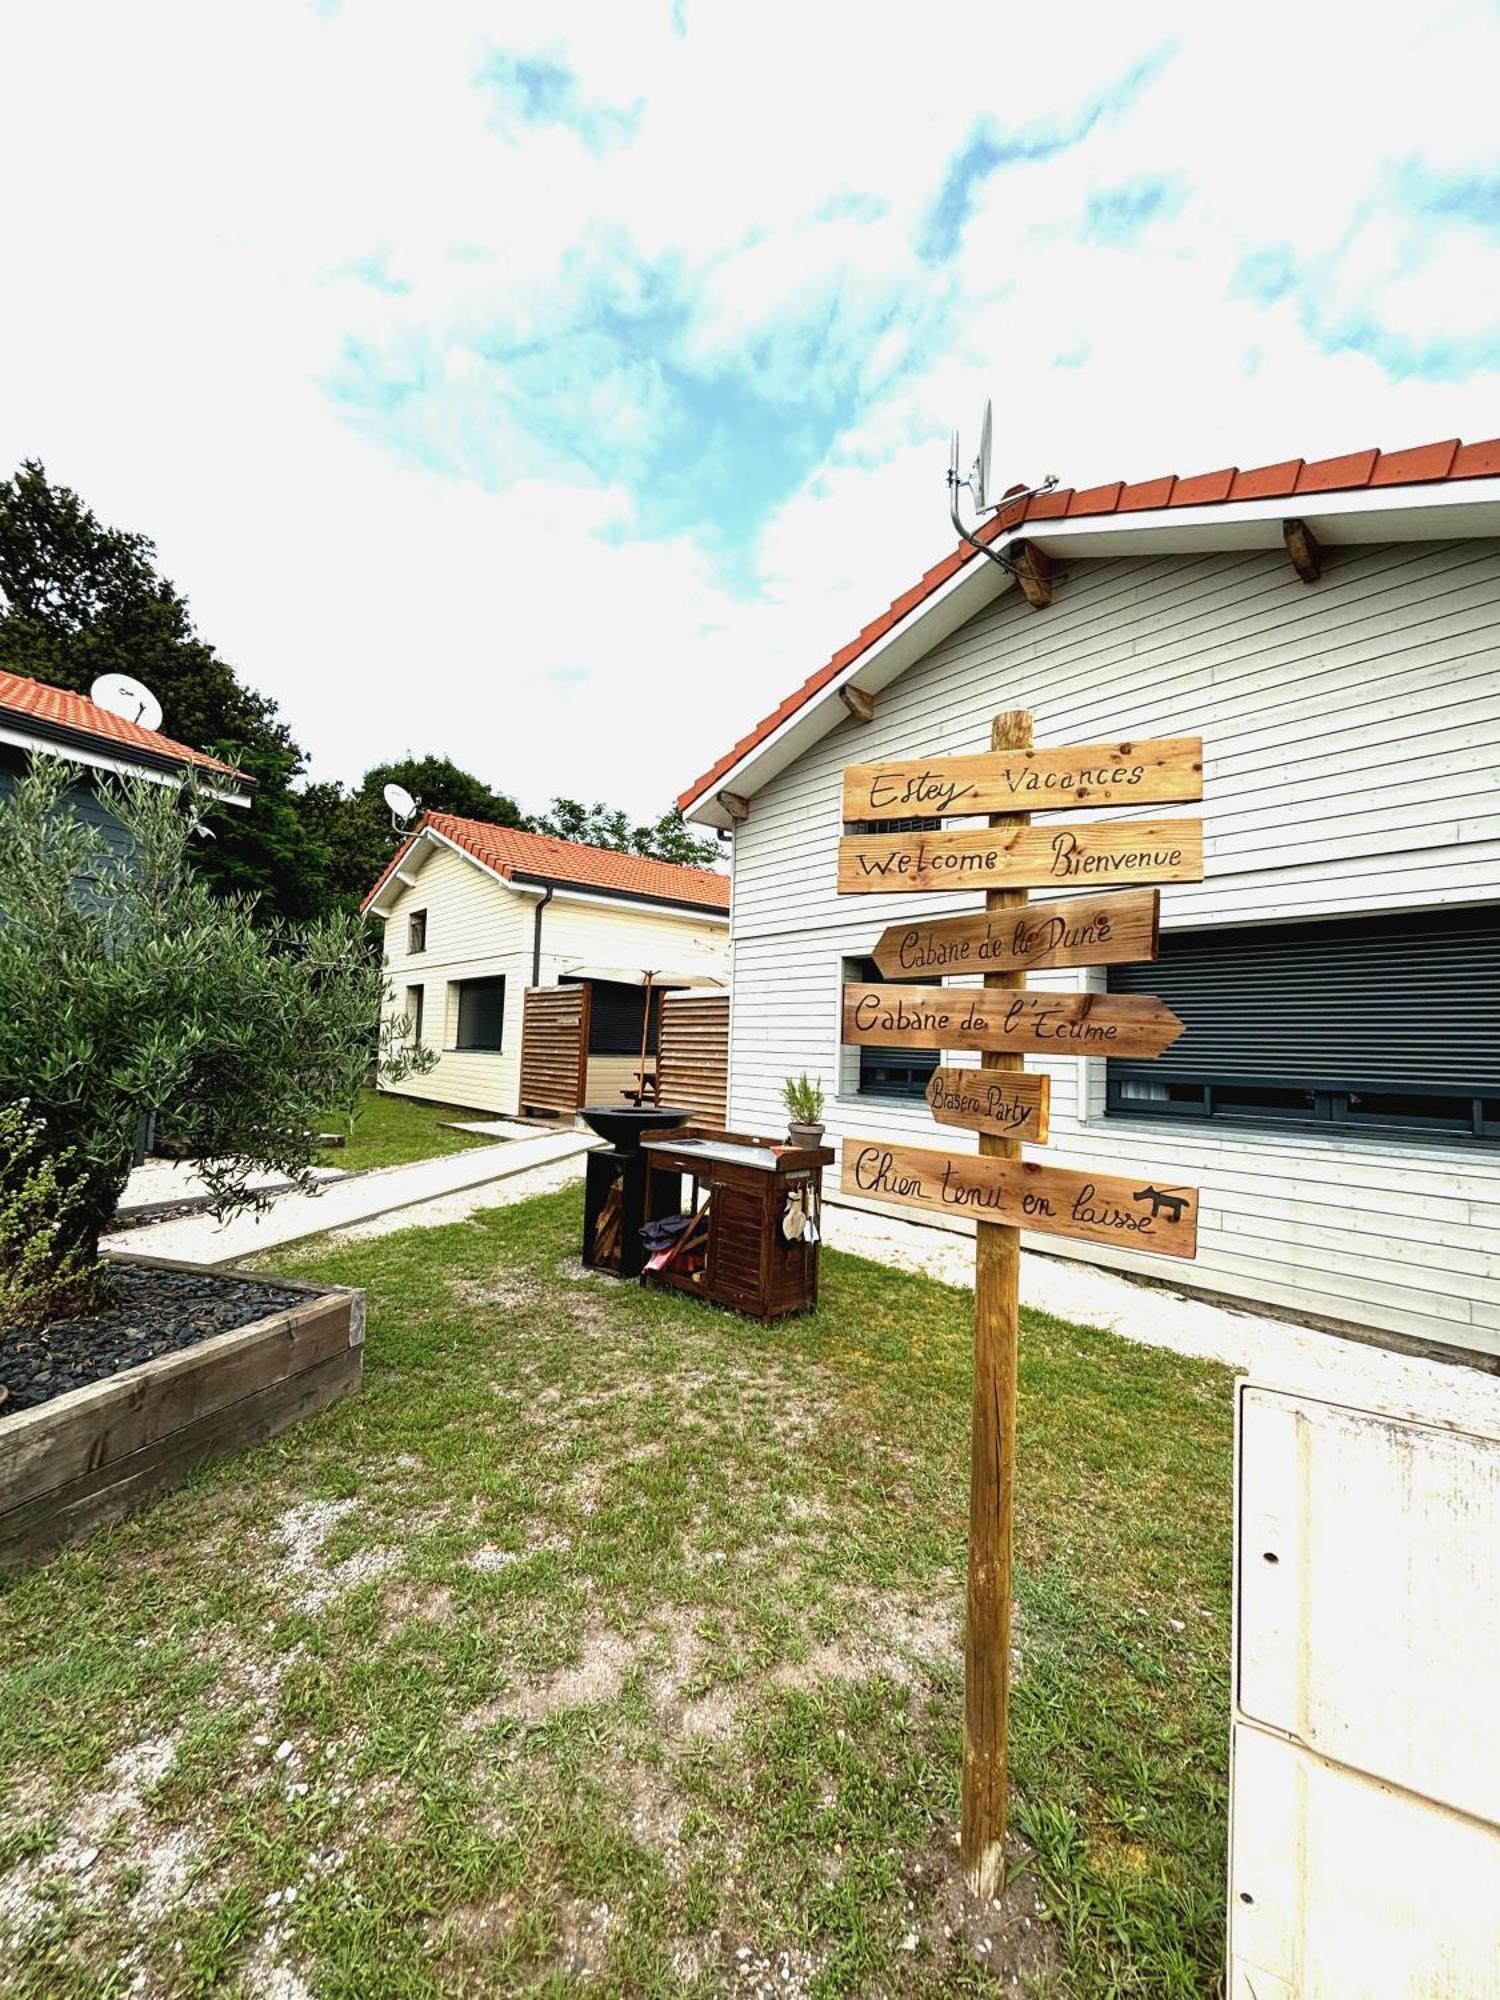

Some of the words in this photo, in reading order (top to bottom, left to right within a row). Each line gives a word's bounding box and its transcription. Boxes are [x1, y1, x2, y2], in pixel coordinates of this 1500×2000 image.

[869, 770, 975, 811] Estey
[1004, 764, 1144, 793] Vacances
[855, 845, 998, 877] Welcome
[1050, 831, 1182, 877] Bienvenue
[899, 931, 969, 969] Cabane
[978, 924, 1002, 958] de
[1011, 915, 1032, 956] la
[1023, 916, 1113, 966] Dune
[855, 994, 949, 1030] Cabane
[960, 1003, 984, 1030] de
[931, 1076, 980, 1113] Brasero
[984, 1085, 1033, 1131] Party
[855, 1147, 932, 1198] Chien
[941, 1161, 1008, 1210] tenu
[1022, 1193, 1056, 1217] en
[1071, 1184, 1157, 1235] laisse
